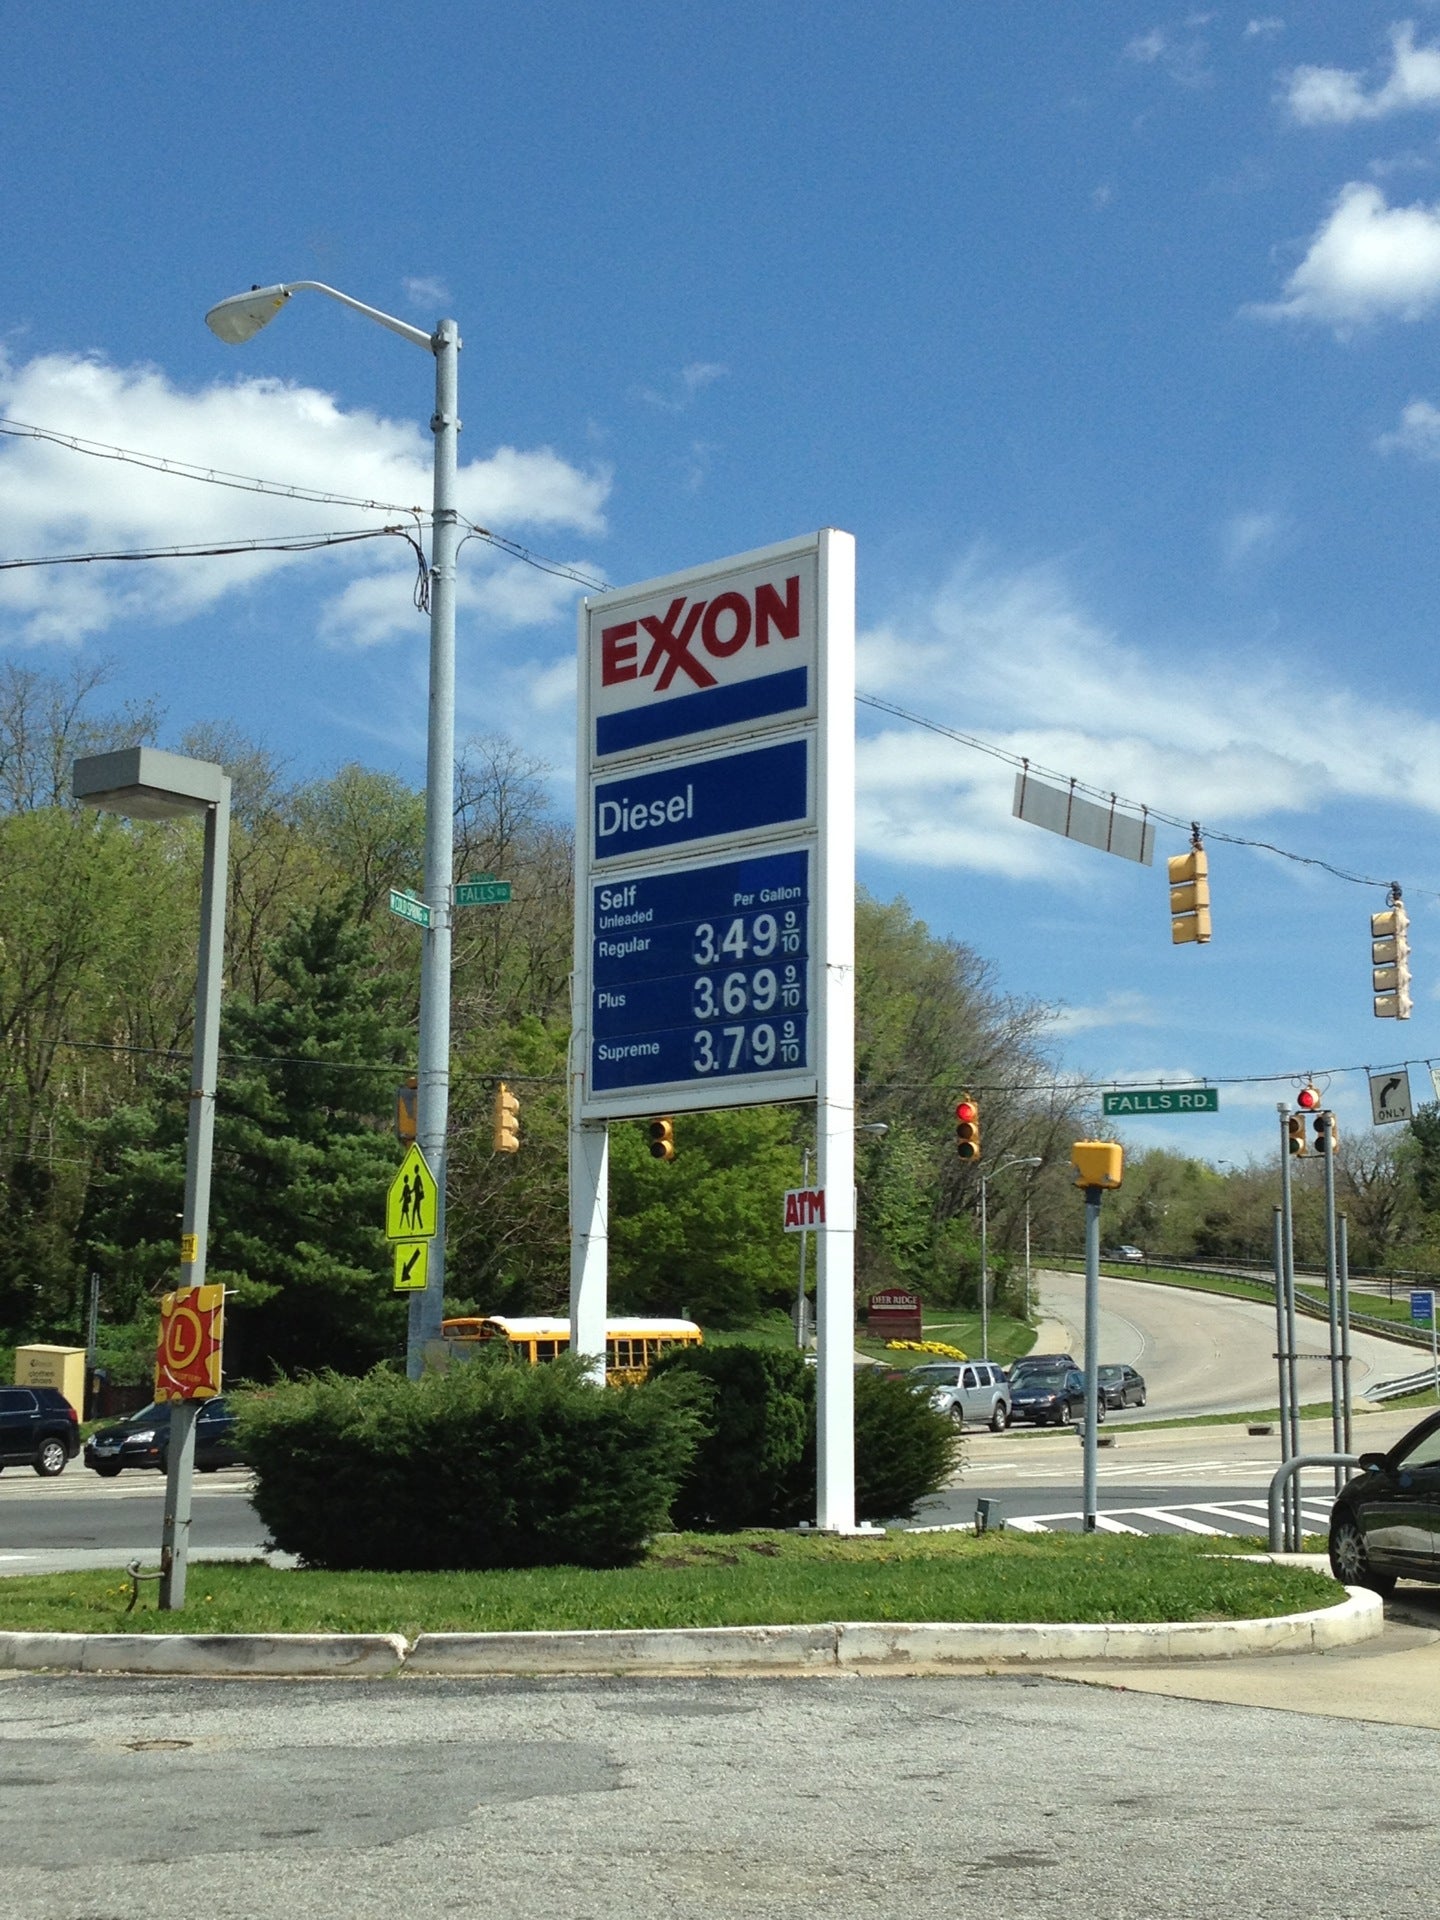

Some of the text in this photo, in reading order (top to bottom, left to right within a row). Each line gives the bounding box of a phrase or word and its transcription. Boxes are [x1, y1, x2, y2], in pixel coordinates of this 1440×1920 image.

[602, 575, 800, 692] EXXON
[599, 783, 693, 838] Diesel
[460, 886, 496, 902] FALLS
[600, 885, 637, 911] Self
[734, 886, 801, 907] Per Gallon
[600, 908, 653, 930] Unleaded
[599, 937, 651, 959] Regular
[694, 914, 777, 965] 3.49
[599, 993, 626, 1009] Plus
[694, 968, 777, 1019] 3.69
[598, 1042, 660, 1062] Supreme
[693, 1023, 776, 1072] 3.79
[1107, 1094, 1213, 1111] FALLS RD.
[1378, 1107, 1406, 1120] ONLY
[785, 1189, 826, 1227] ATM
[872, 1295, 917, 1304] DEER RIDGE
